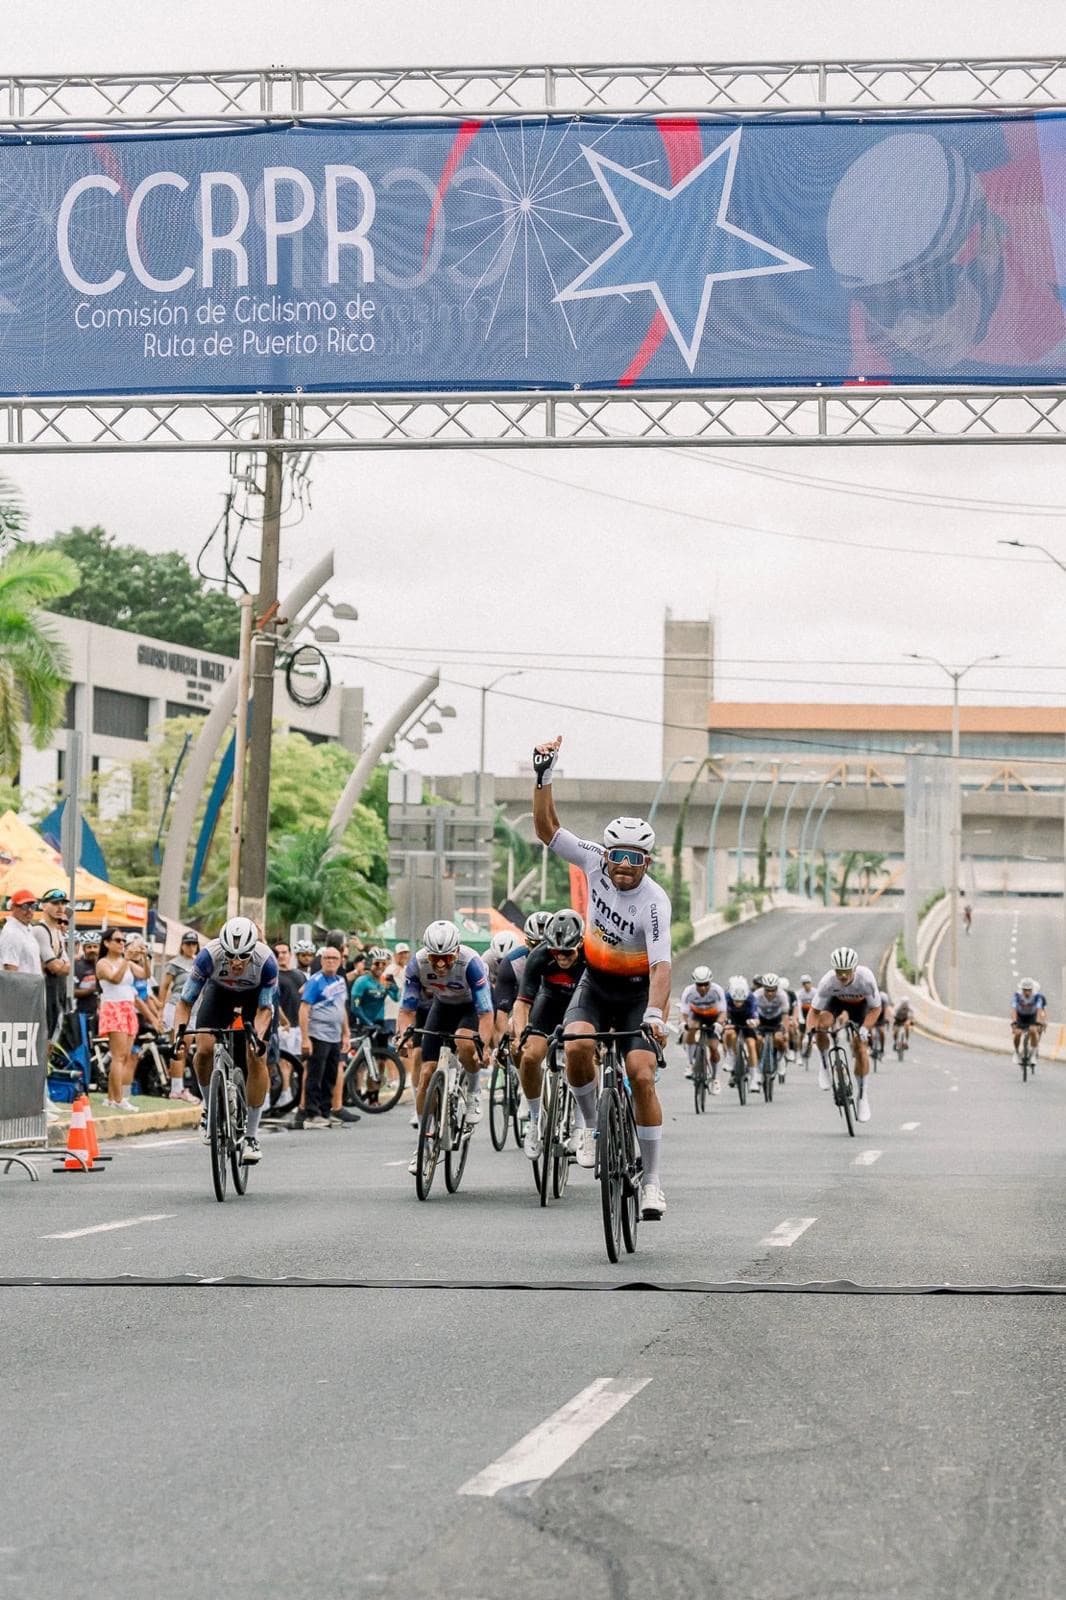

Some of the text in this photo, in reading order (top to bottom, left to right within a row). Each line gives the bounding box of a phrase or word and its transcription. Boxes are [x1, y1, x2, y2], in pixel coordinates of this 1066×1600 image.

[57, 164, 376, 295] CCRPR
[75, 293, 376, 329] Comisión de Ciclismo de
[144, 327, 375, 358] Ruta de Puerto Rico
